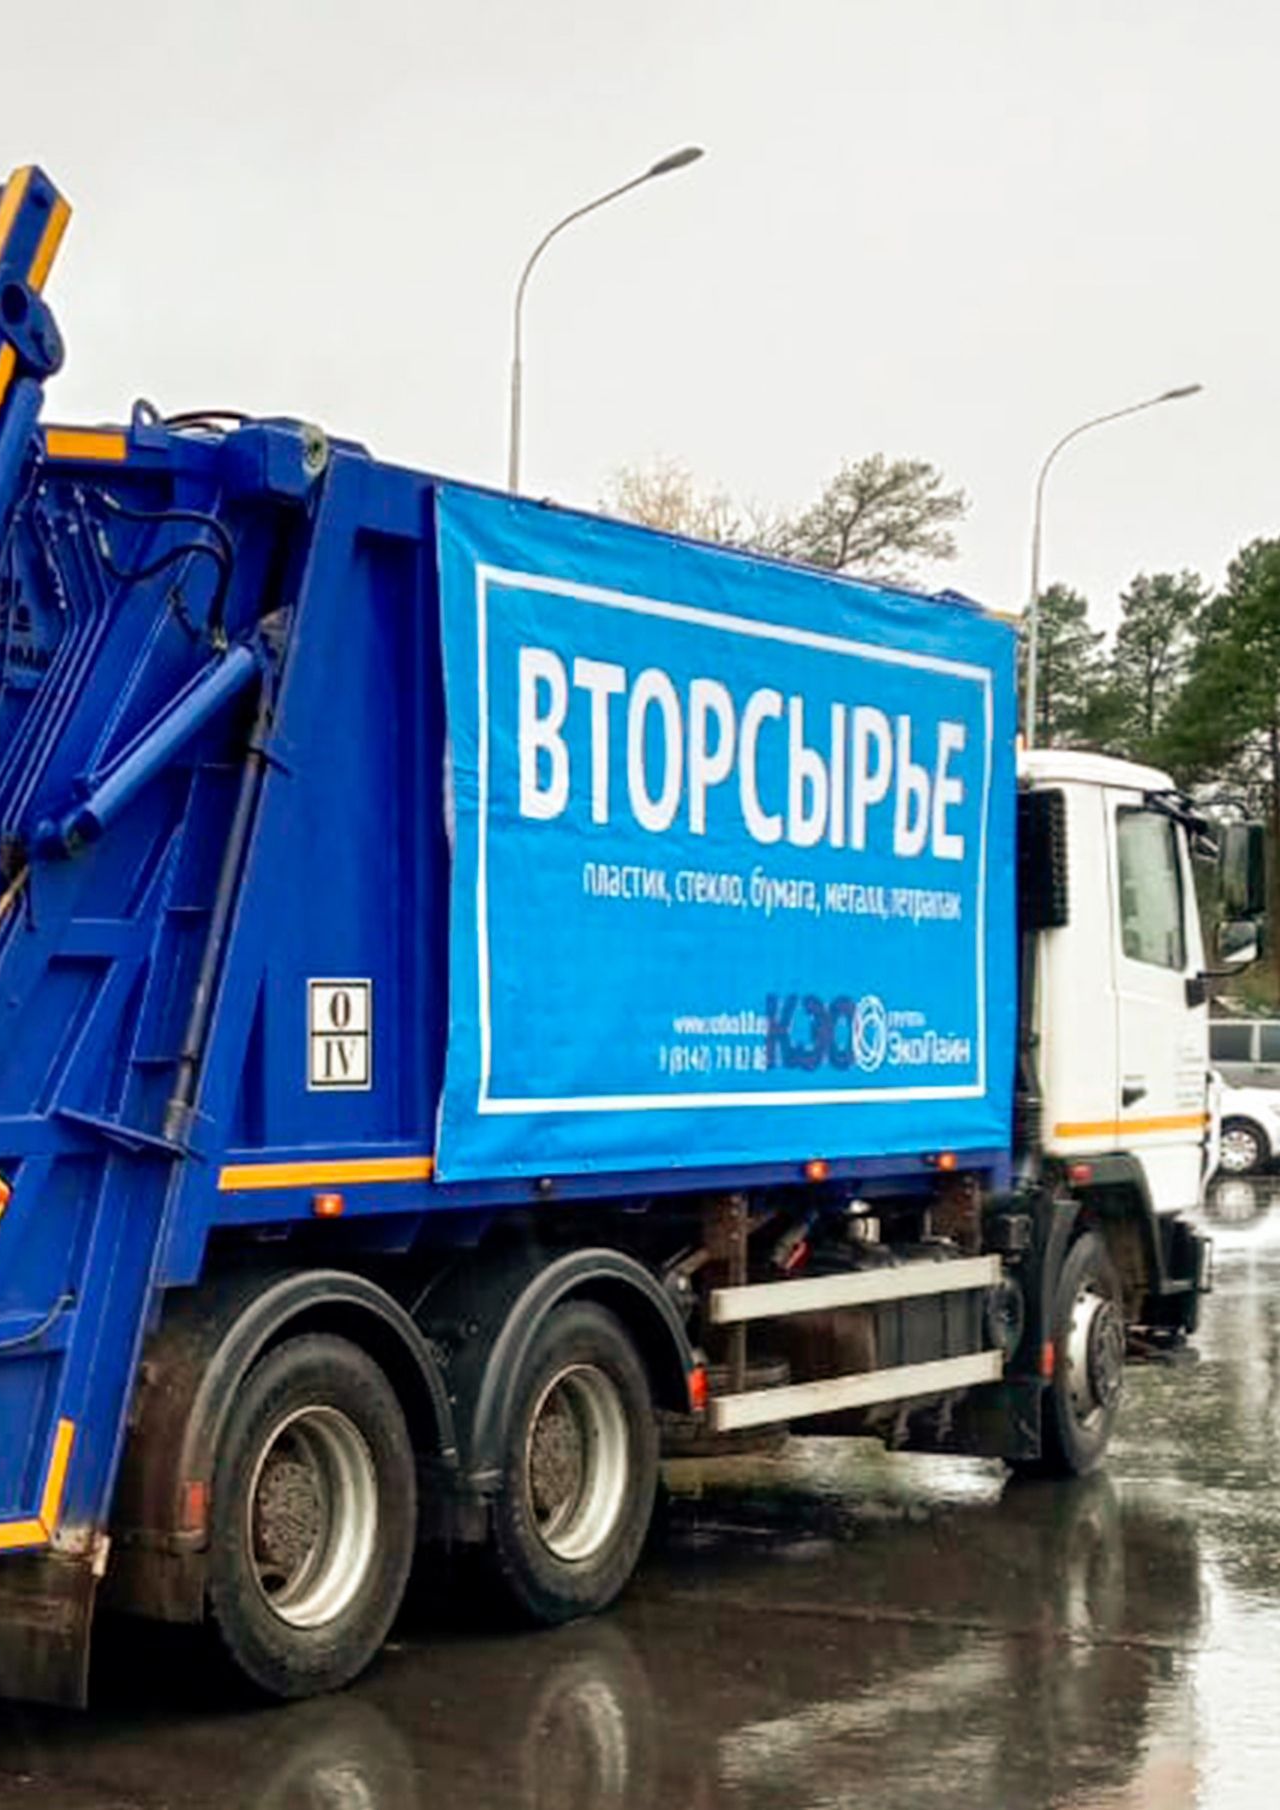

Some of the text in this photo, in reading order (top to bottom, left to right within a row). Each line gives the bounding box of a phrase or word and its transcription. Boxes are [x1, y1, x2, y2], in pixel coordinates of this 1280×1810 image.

[518, 645, 967, 861] ВТОРСЫРЬЕ
[582, 861, 673, 908] пластик,
[675, 870, 748, 914] стекло,
[750, 865, 821, 919] бумага,
[322, 1039, 357, 1078] IV
